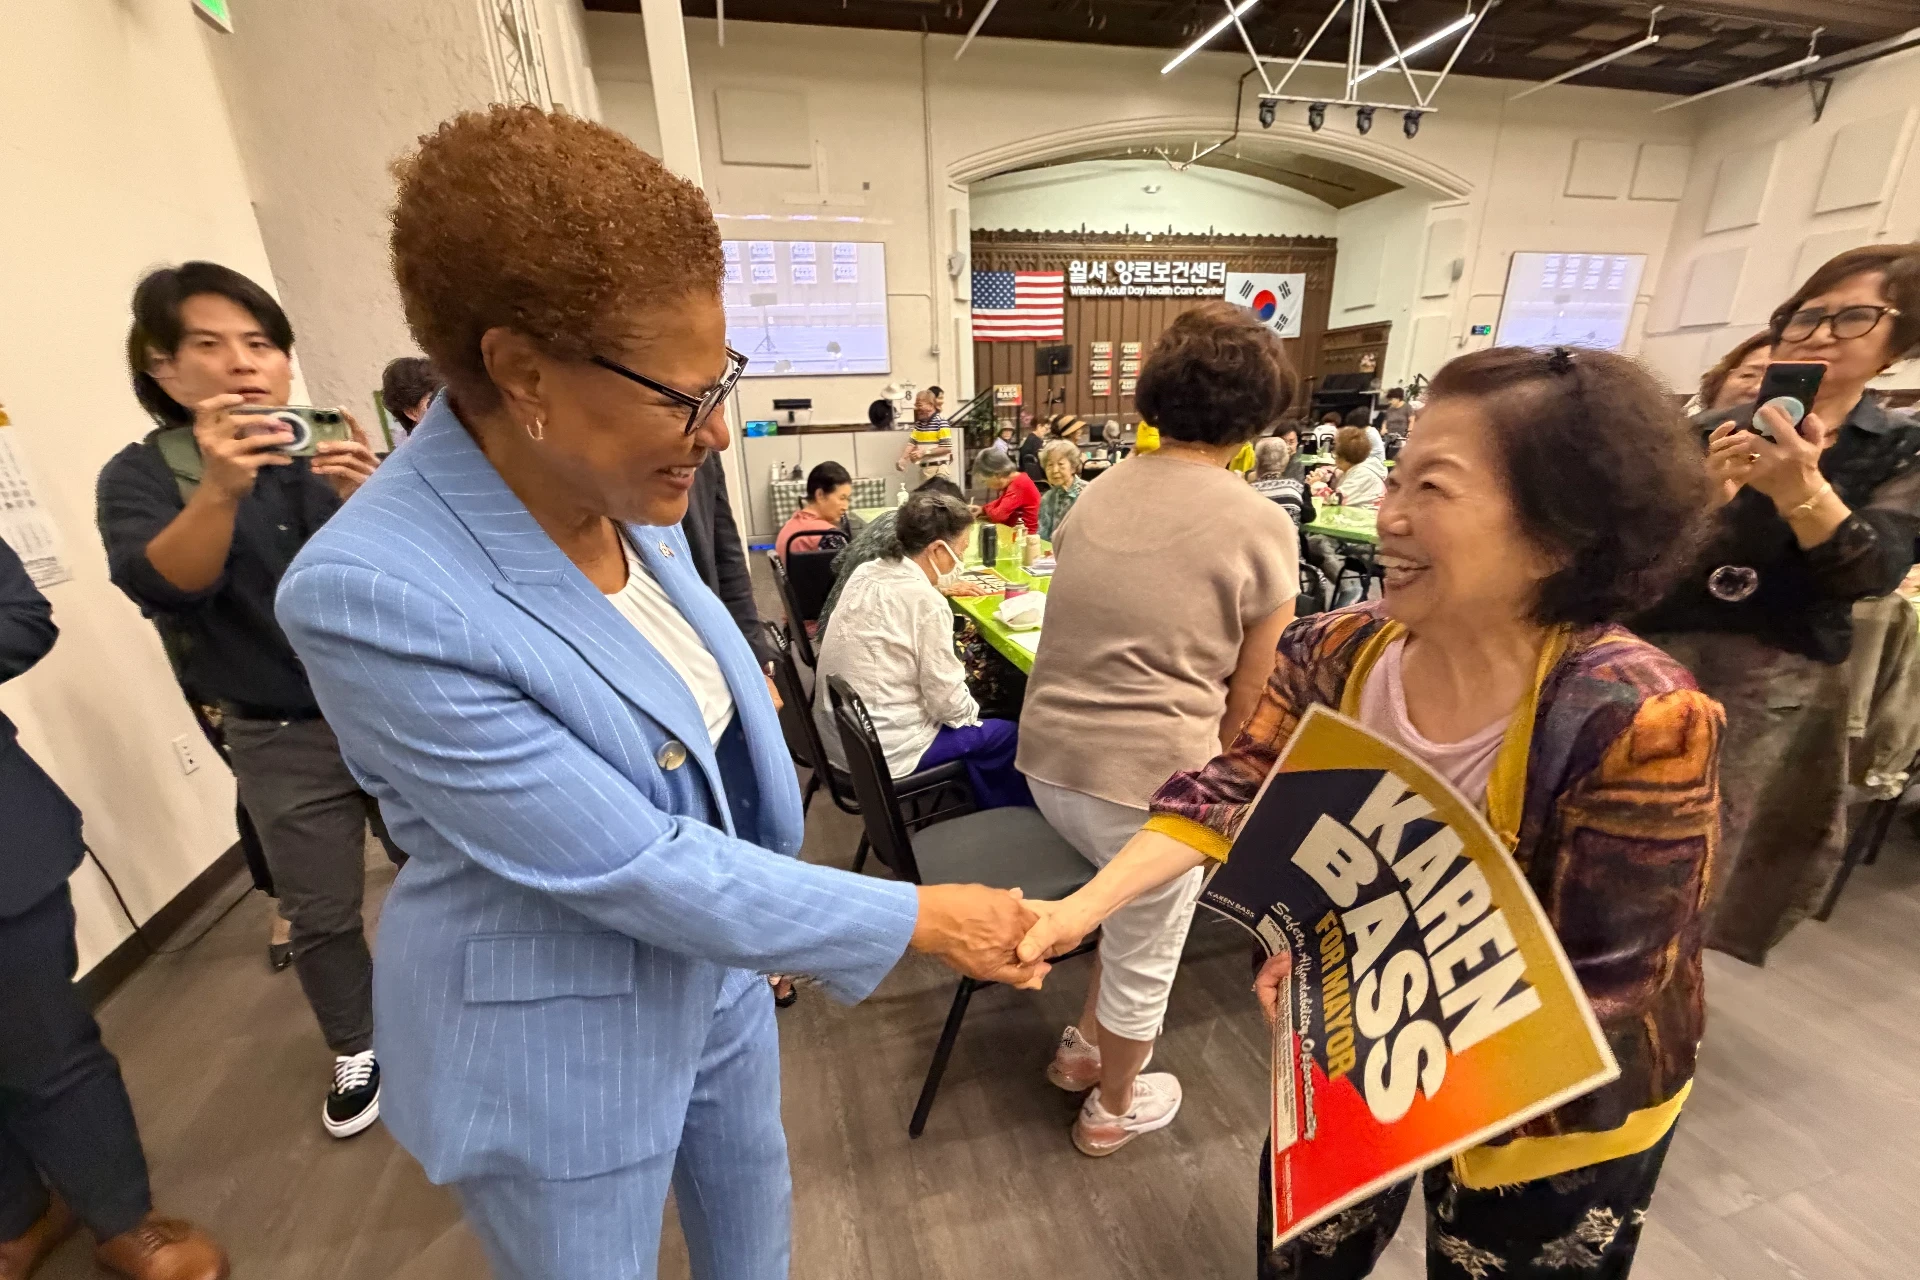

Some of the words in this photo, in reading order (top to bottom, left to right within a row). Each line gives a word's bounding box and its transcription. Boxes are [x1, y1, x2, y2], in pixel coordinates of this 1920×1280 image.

[1104, 285, 1126, 295] Adult
[1127, 285, 1145, 297] Day
[1173, 285, 1195, 295] Care
[1196, 285, 1225, 295] Center
[1114, 260, 1226, 285] 양로보건센터
[1206, 890, 1235, 907] KAREN
[1235, 902, 1256, 918] BASS
[1350, 771, 1542, 1056] KAREN
[1290, 812, 1447, 1125] BASS
[1314, 908, 1345, 973] FOR
[1322, 961, 1357, 1083] MAYOR
